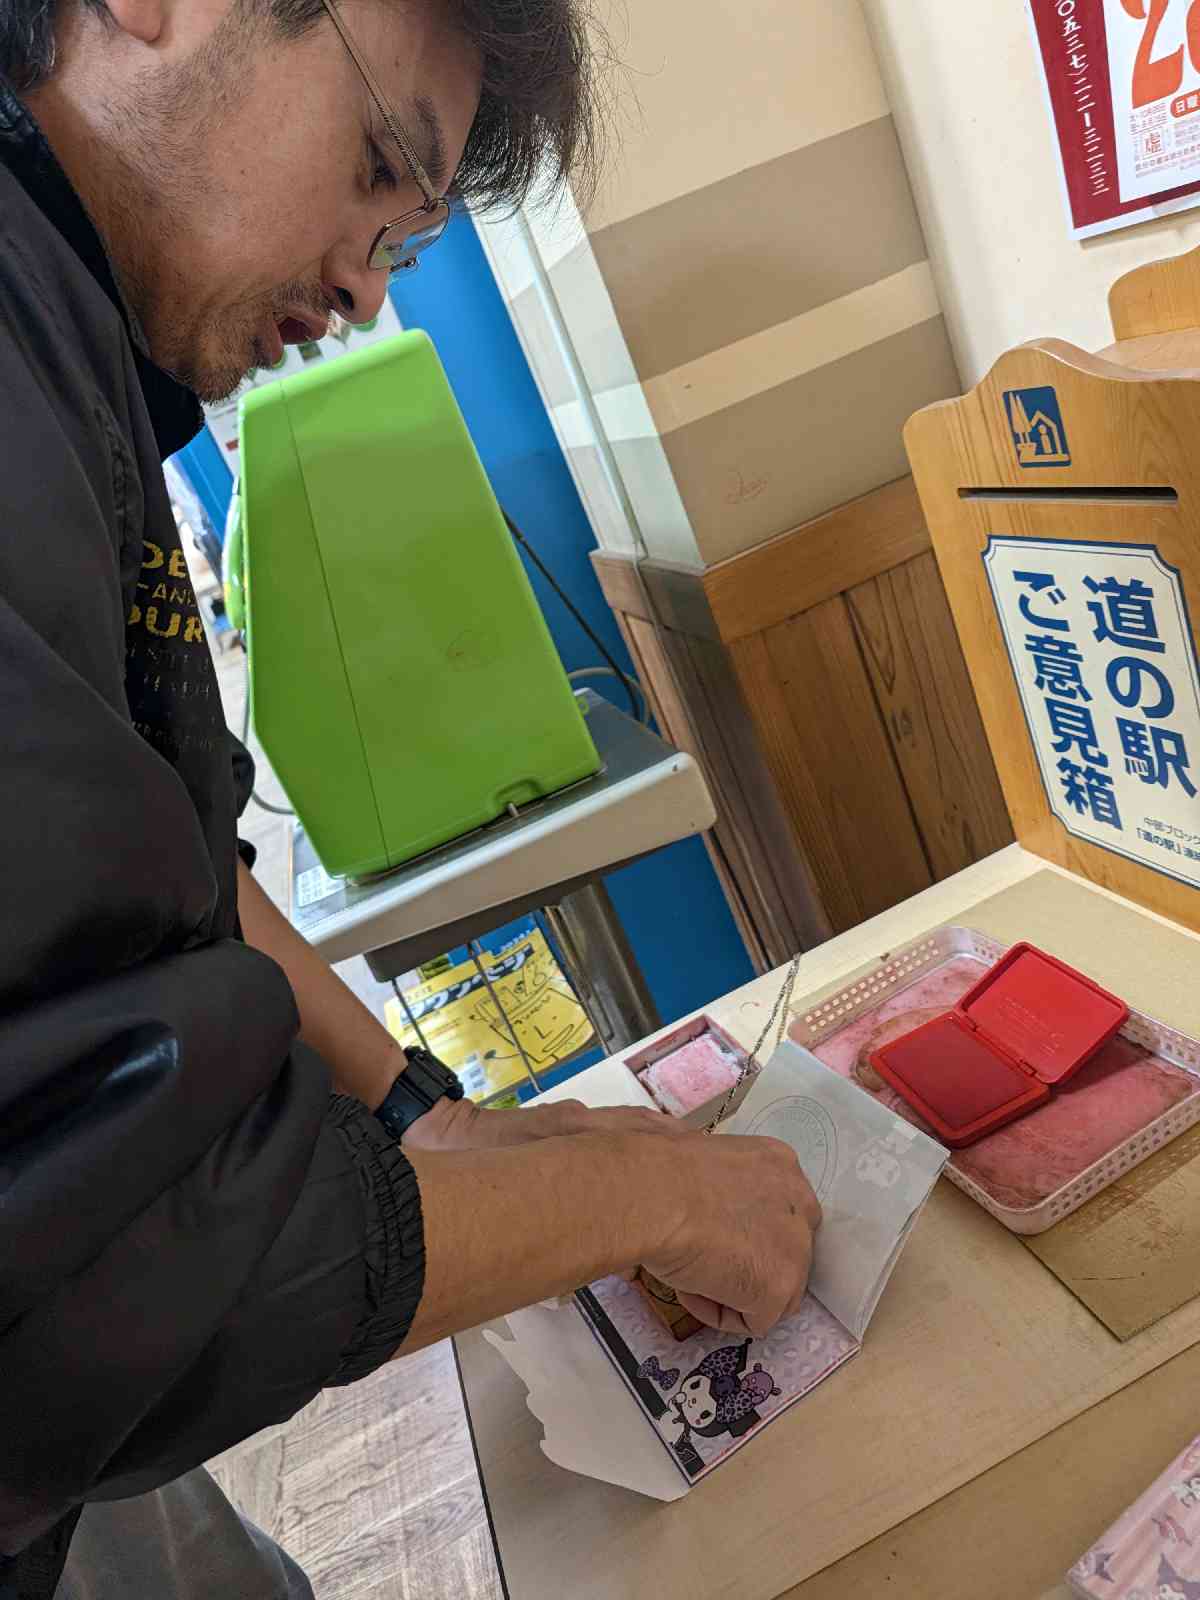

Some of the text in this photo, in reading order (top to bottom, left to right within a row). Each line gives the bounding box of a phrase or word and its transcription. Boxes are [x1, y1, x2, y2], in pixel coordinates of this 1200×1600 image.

[1012, 570, 1124, 831] ご意見箱
[1082, 573, 1198, 798] 道の駅
